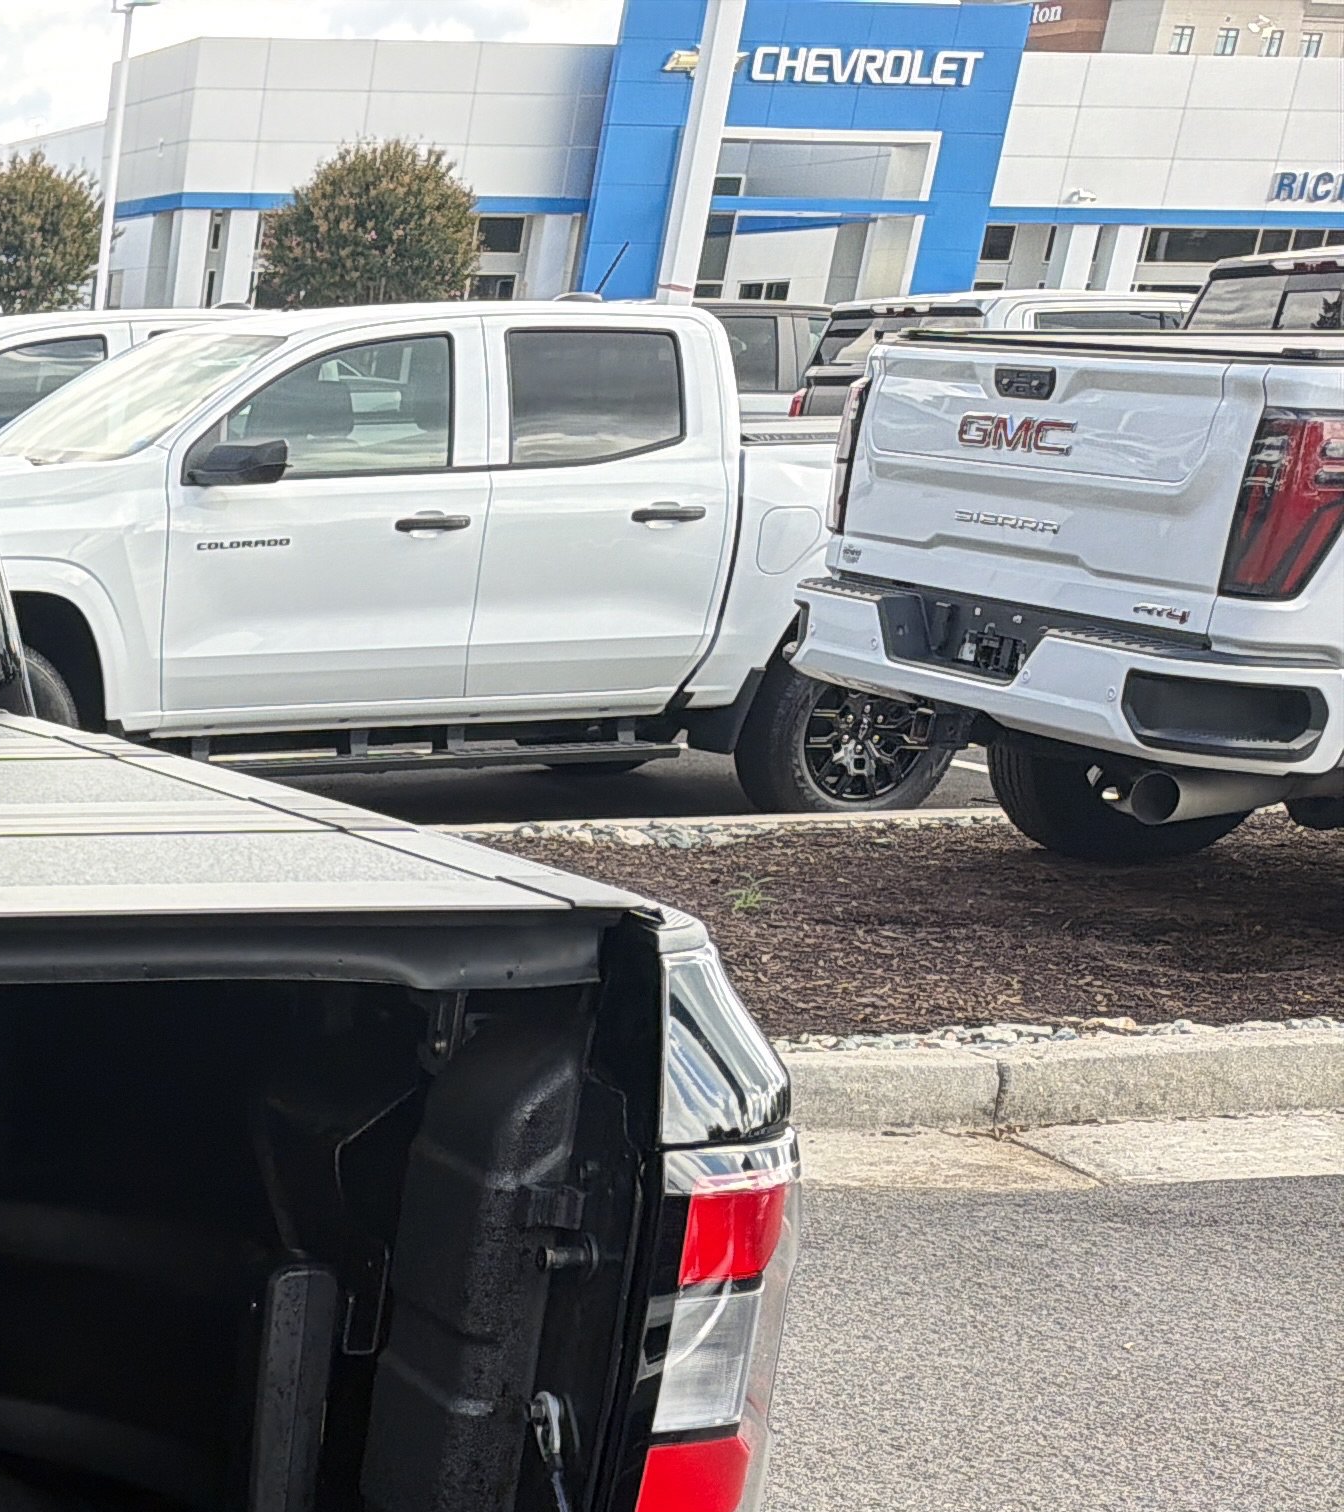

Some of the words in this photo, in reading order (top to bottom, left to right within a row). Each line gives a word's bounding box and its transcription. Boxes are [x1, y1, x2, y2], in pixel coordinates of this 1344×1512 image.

[1032, 4, 1062, 24] ton
[751, 46, 985, 87] CHEVROLET
[957, 410, 1079, 457] GMC
[954, 508, 1060, 534] SIERRA
[196, 538, 291, 551] COLORADO
